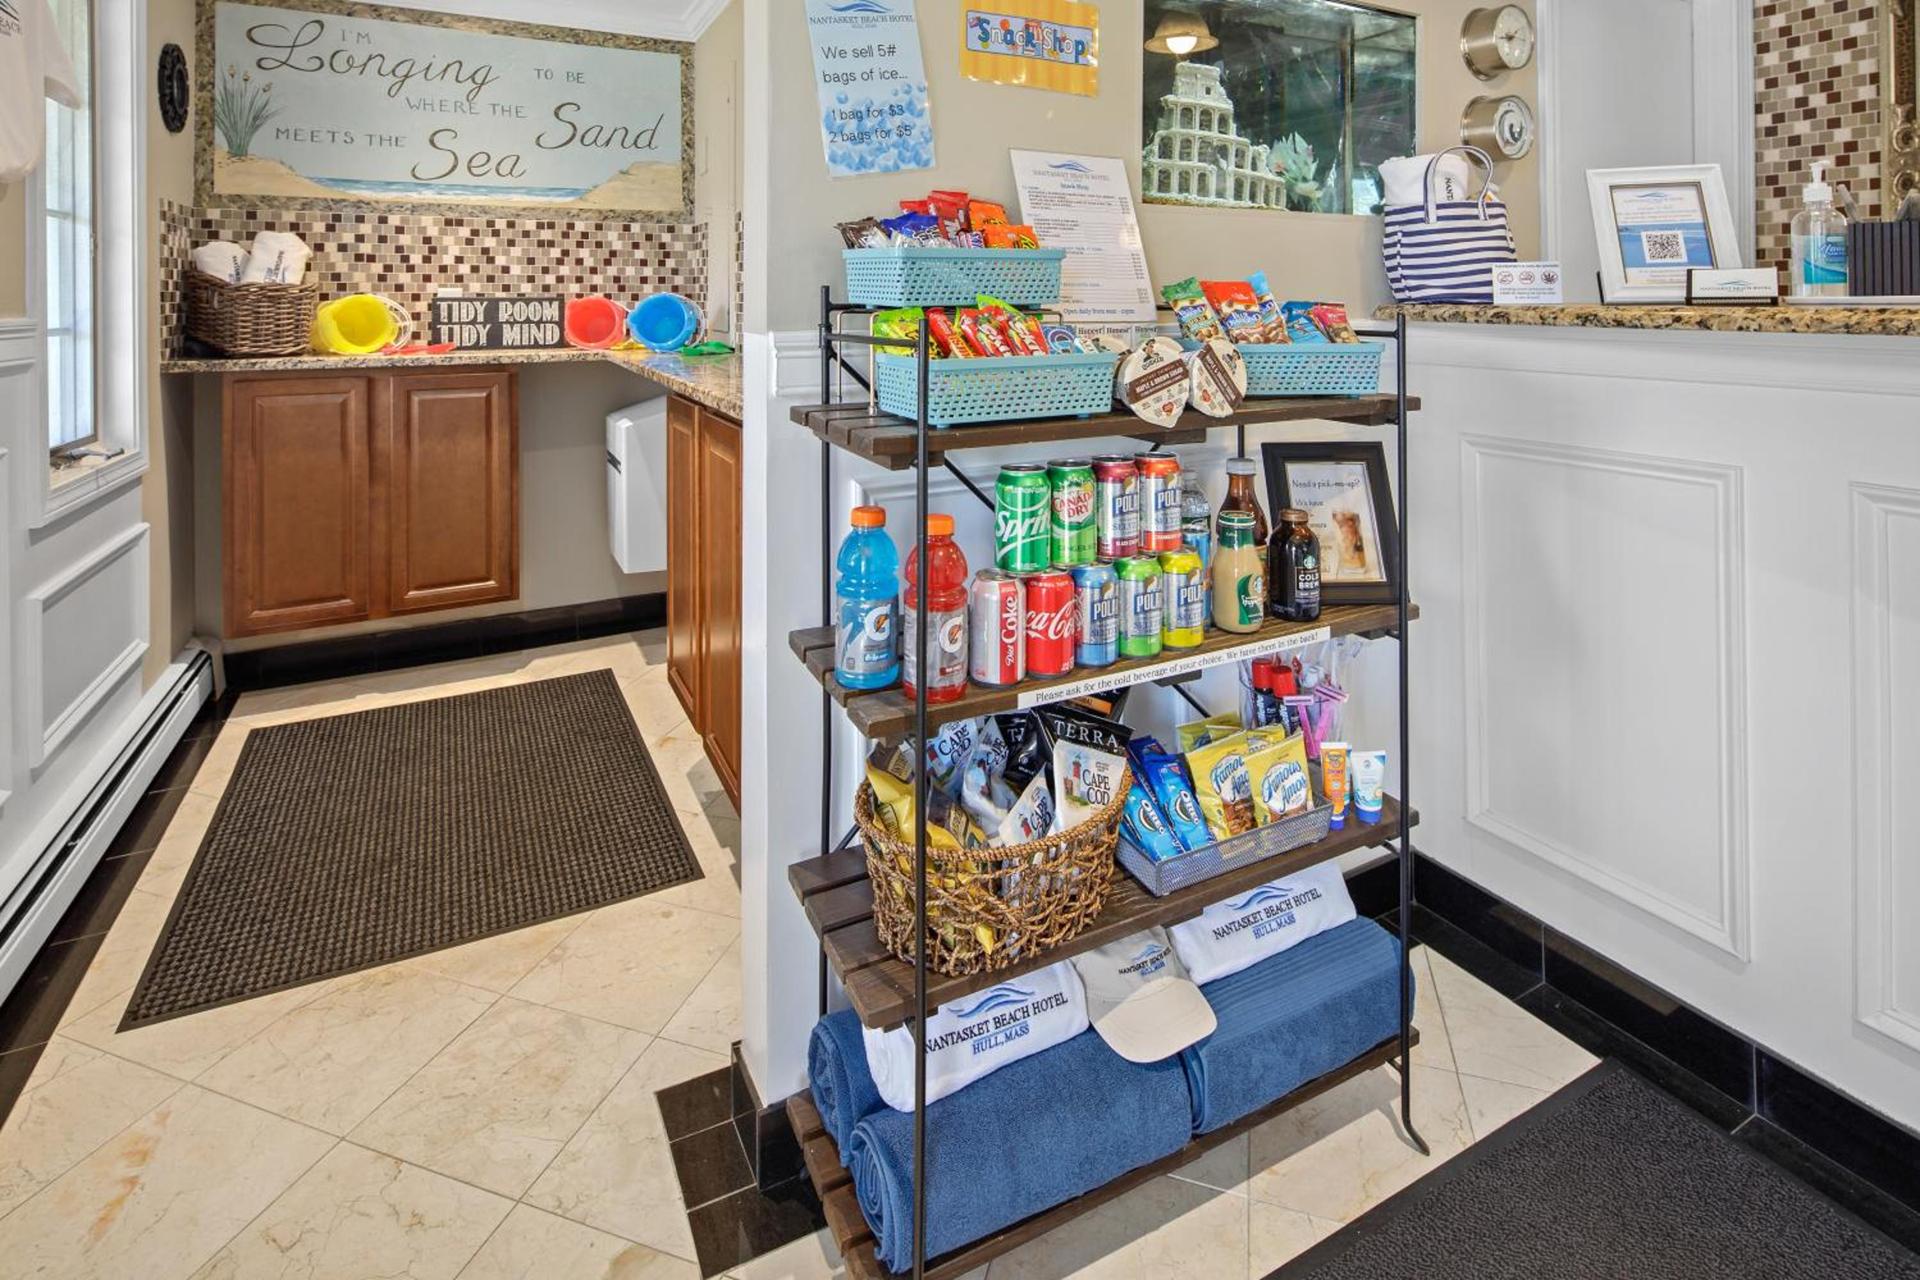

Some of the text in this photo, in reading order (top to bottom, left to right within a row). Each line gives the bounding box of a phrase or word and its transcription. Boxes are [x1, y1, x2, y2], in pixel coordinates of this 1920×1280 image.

[340, 29, 372, 44] I'M
[821, 44, 897, 59] We sell 5#
[978, 18, 1086, 63] Snack Shop
[246, 20, 585, 101] Longing TO BE
[822, 70, 857, 86] bags
[861, 68, 874, 81] of
[404, 96, 665, 150] WHERE THE Sand
[832, 104, 905, 122] 1 bag for $3
[829, 125, 912, 144] 2 bags for $5
[275, 127, 527, 181] MEETS THE Sea
[437, 301, 559, 323] TIDY ROOM
[437, 324, 560, 347] TIDY MIND
[1053, 492, 1092, 512] CANAD
[1067, 503, 1089, 517] DRY
[996, 508, 1051, 542] Sprit
[1002, 596, 1017, 644] Coke
[1036, 690, 1064, 702] Please
[1065, 686, 1083, 696] ask
[1083, 682, 1095, 692] for
[1097, 679, 1112, 690] the
[1114, 674, 1131, 686] cold
[1133, 667, 1168, 682] beverage
[1169, 664, 1178, 674] of
[1179, 661, 1197, 673] your
[1226, 651, 1237, 660] We
[1239, 649, 1256, 657] have
[1257, 643, 1276, 655] them
[1278, 641, 1285, 649] in
[1287, 637, 1298, 647] the
[1299, 633, 1318, 645] back!
[938, 723, 970, 756] CAPE
[1055, 720, 1118, 748] TERRA
[951, 737, 971, 765] COD
[1082, 769, 1110, 791] CAPE
[1087, 786, 1110, 806] COD
[1262, 760, 1302, 803] Famous
[1280, 777, 1306, 812] Amos
[1141, 799, 1164, 835] OREO
[1180, 790, 1199, 825] OREO
[1212, 888, 1322, 940] NANTASKET BEACH HOTEL
[925, 992, 1068, 1054] NANTASKET BEACH HOTEL
[972, 1024, 1030, 1055] HULL, MASS
